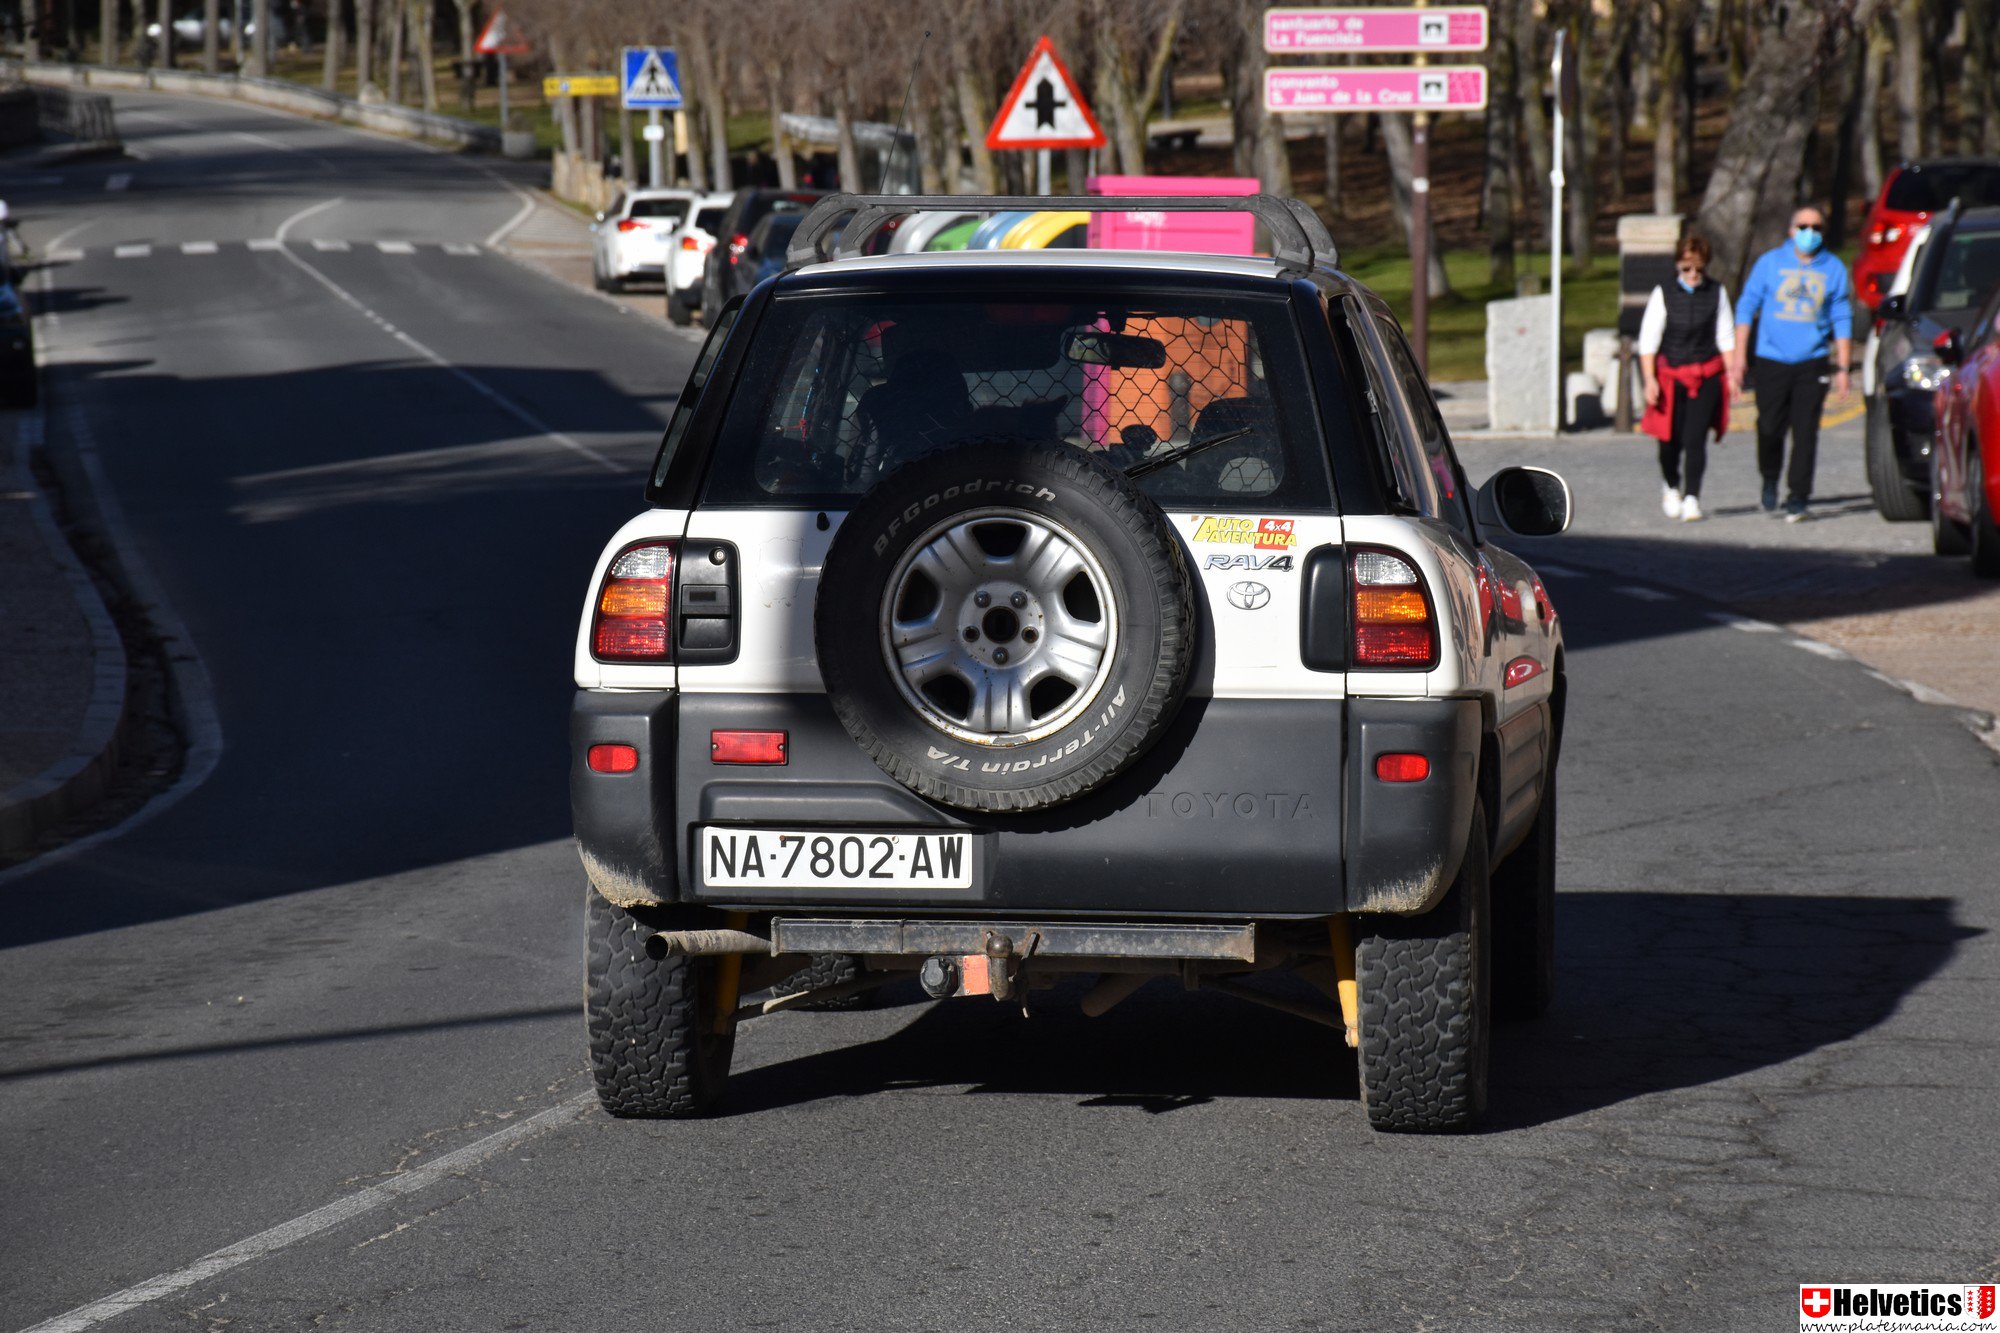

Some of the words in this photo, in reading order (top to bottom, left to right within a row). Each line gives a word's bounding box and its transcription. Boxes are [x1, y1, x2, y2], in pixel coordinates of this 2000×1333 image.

[1344, 17, 1364, 30] de
[1271, 32, 1289, 45] La
[1271, 76, 1339, 88] convento
[1293, 91, 1326, 103] Juan
[1331, 90, 1350, 103] de
[1356, 90, 1372, 103] la
[1378, 88, 1413, 103] Cruz
[873, 478, 1056, 557] BFGoodrich
[1264, 520, 1292, 532] 4x4
[1207, 530, 1297, 546] AVENTURA
[1203, 554, 1294, 572] RAV4
[981, 684, 1126, 775] All-Terrain
[927, 745, 971, 771] T/A
[1142, 792, 1313, 819] TOYOTA
